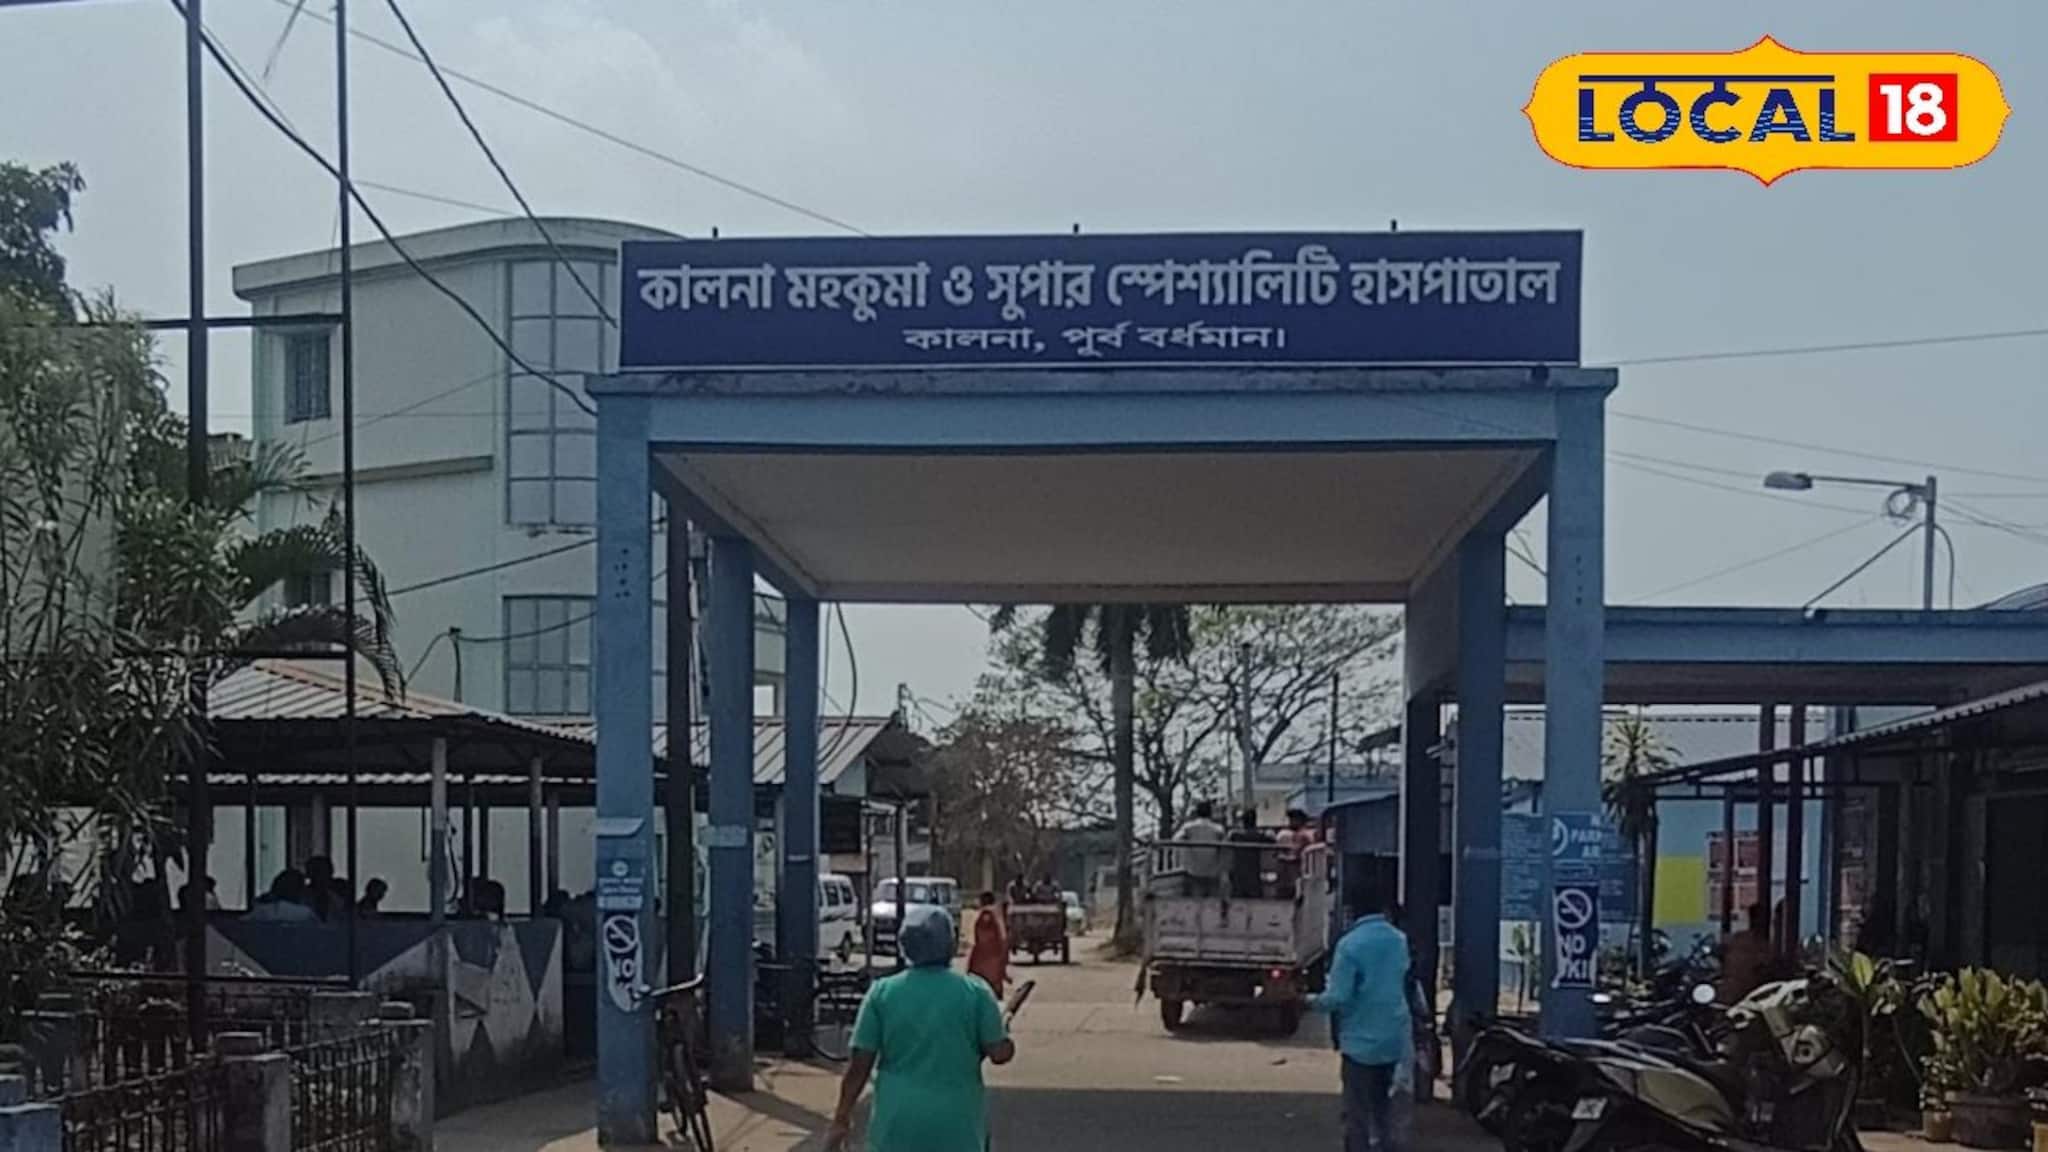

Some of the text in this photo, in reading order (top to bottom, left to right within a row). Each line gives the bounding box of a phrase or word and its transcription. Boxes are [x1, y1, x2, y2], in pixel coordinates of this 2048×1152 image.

[638, 246, 1560, 321] কালনা মহকুমা ও সুপার স্পেশ্যালিটি হাসপাতাল
[904, 328, 1044, 350] কালনা,
[1062, 321, 1131, 356] পূর্ব
